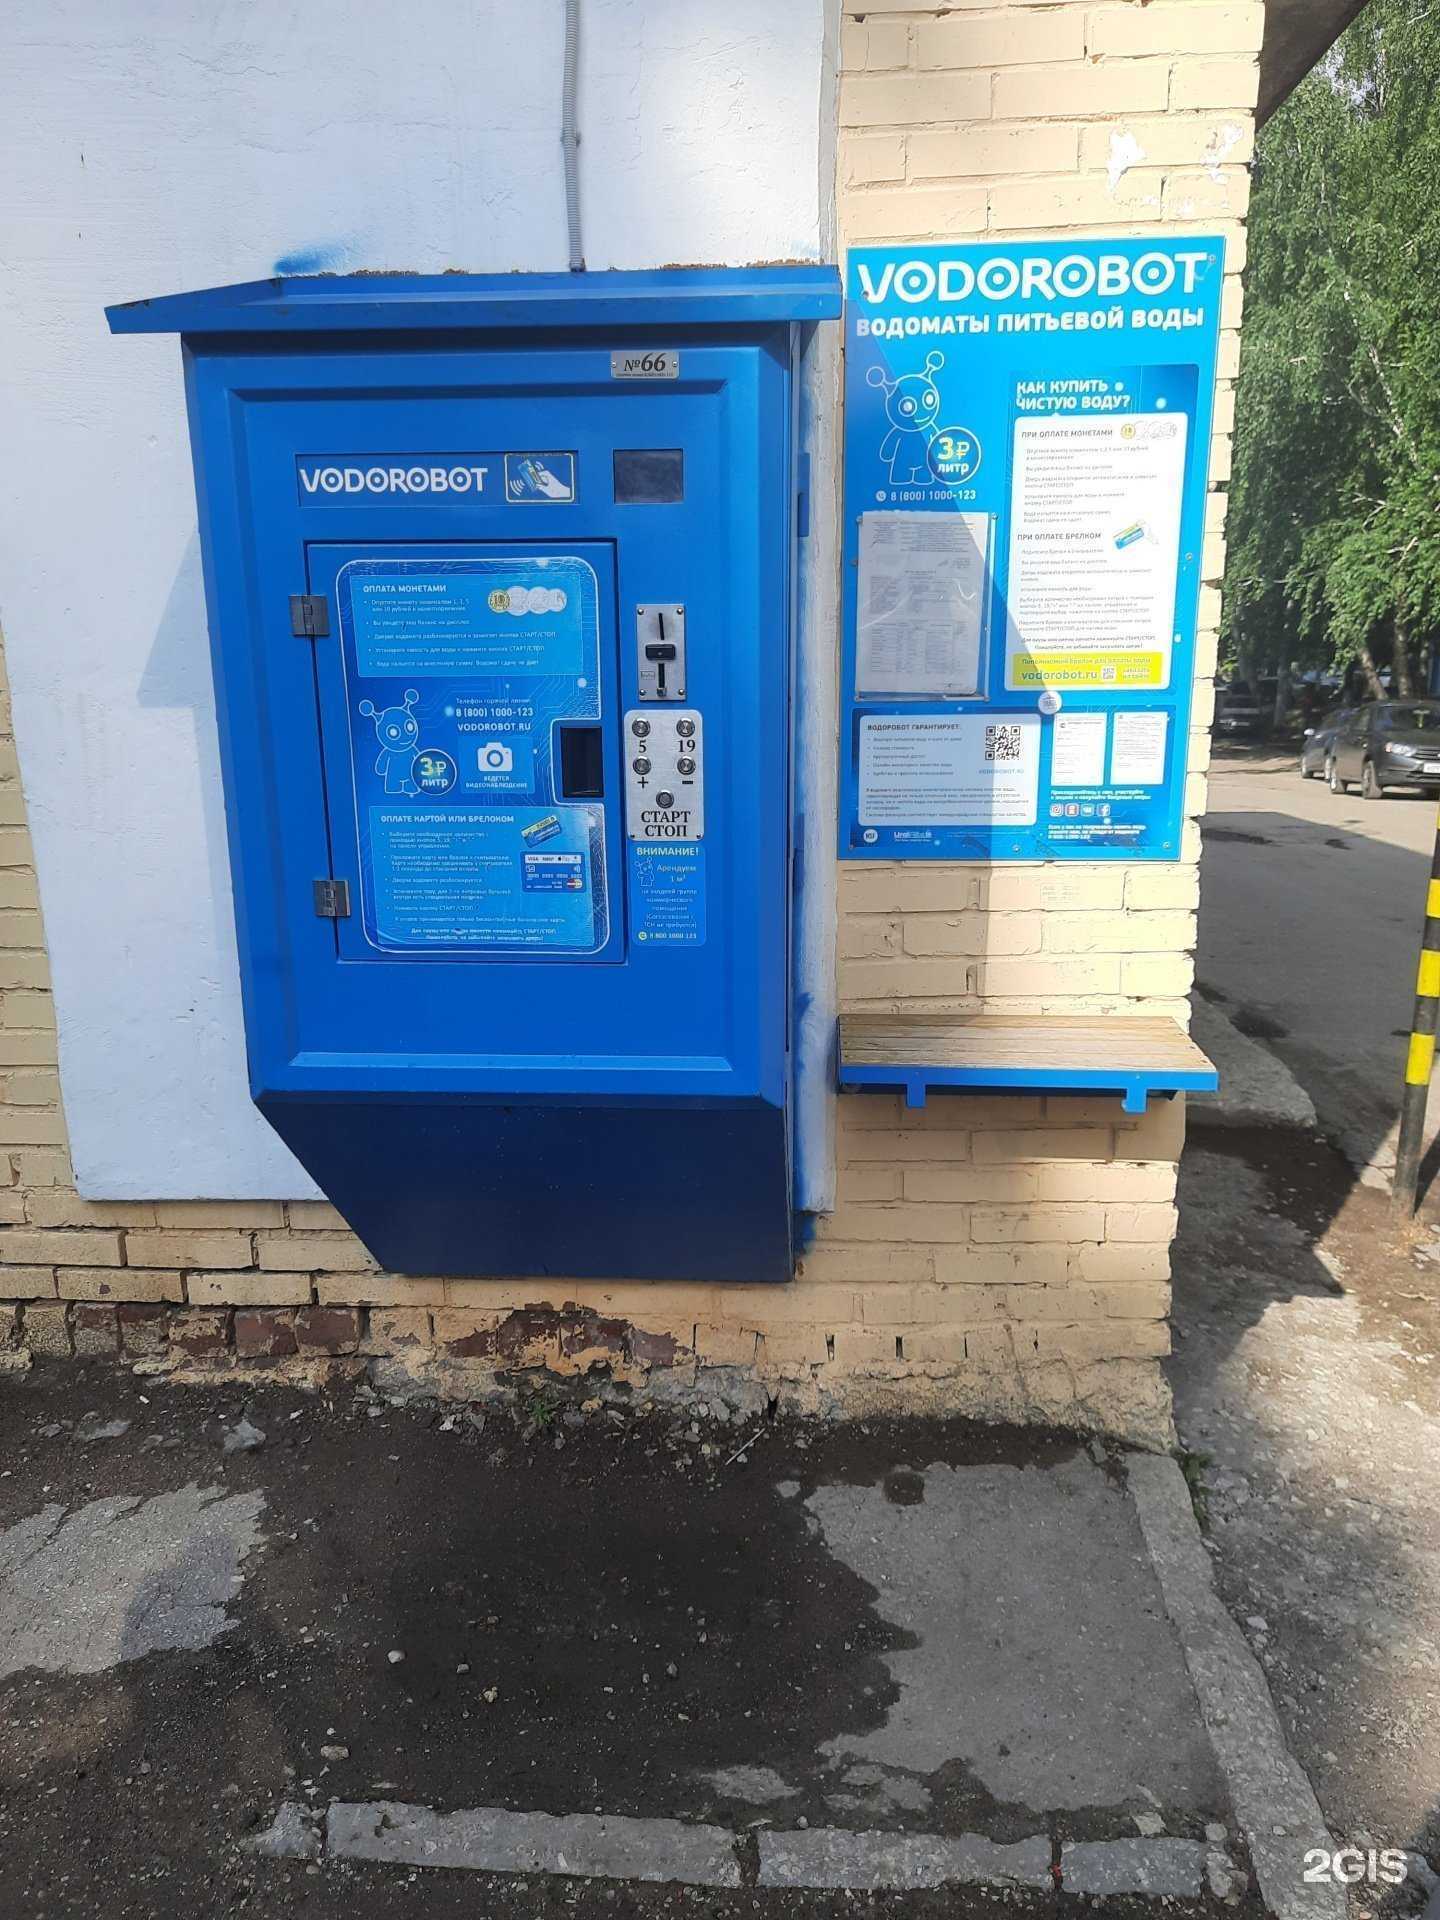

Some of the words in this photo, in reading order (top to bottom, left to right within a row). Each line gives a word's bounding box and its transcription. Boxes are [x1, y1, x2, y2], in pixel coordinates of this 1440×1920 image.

[857, 252, 1208, 304] VODOROBOT
[856, 313, 990, 341] ВОДОМАТЫ
[997, 304, 1124, 334] ПИТЬЕВОЙ
[1131, 307, 1205, 332] ВОДЫ
[1016, 381, 1047, 395] КАК
[1050, 379, 1109, 395] КУПИТЬ
[1016, 396, 1078, 411] ЧИСТУЮ
[1081, 394, 1132, 411] ВОДУ?
[1040, 430, 1069, 438] ОПЛАТЕ
[1070, 430, 1113, 438] МОНЕТАМИ
[936, 462, 971, 475] литр
[300, 466, 489, 494] VODOROBOT
[890, 491, 897, 501] 8
[899, 490, 926, 502] (800)
[929, 489, 977, 501] 1000-123
[1065, 532, 1101, 540] БРЕЛКОМ
[363, 585, 397, 593] ОПЛАТА
[398, 584, 448, 593] МОНЕТАМИ
[1021, 670, 1098, 680] vodorobot.ru
[455, 708, 462, 717] 8
[464, 707, 488, 718] (800)
[491, 707, 533, 717] 1000-123
[457, 722, 531, 731] VODOROBOT.RU
[638, 739, 648, 752] 5
[678, 739, 696, 752] 19
[421, 779, 449, 788] литр
[380, 815, 412, 823] ОПЛАТЕ
[413, 813, 447, 823] КАРТОЙ
[448, 815, 466, 823] ИЛИ
[468, 815, 514, 823] БРЕЛОКОМ
[640, 810, 691, 824] СТАРТ
[644, 825, 688, 838] СТОП
[636, 847, 699, 857] ВНИМАНИЕ!
